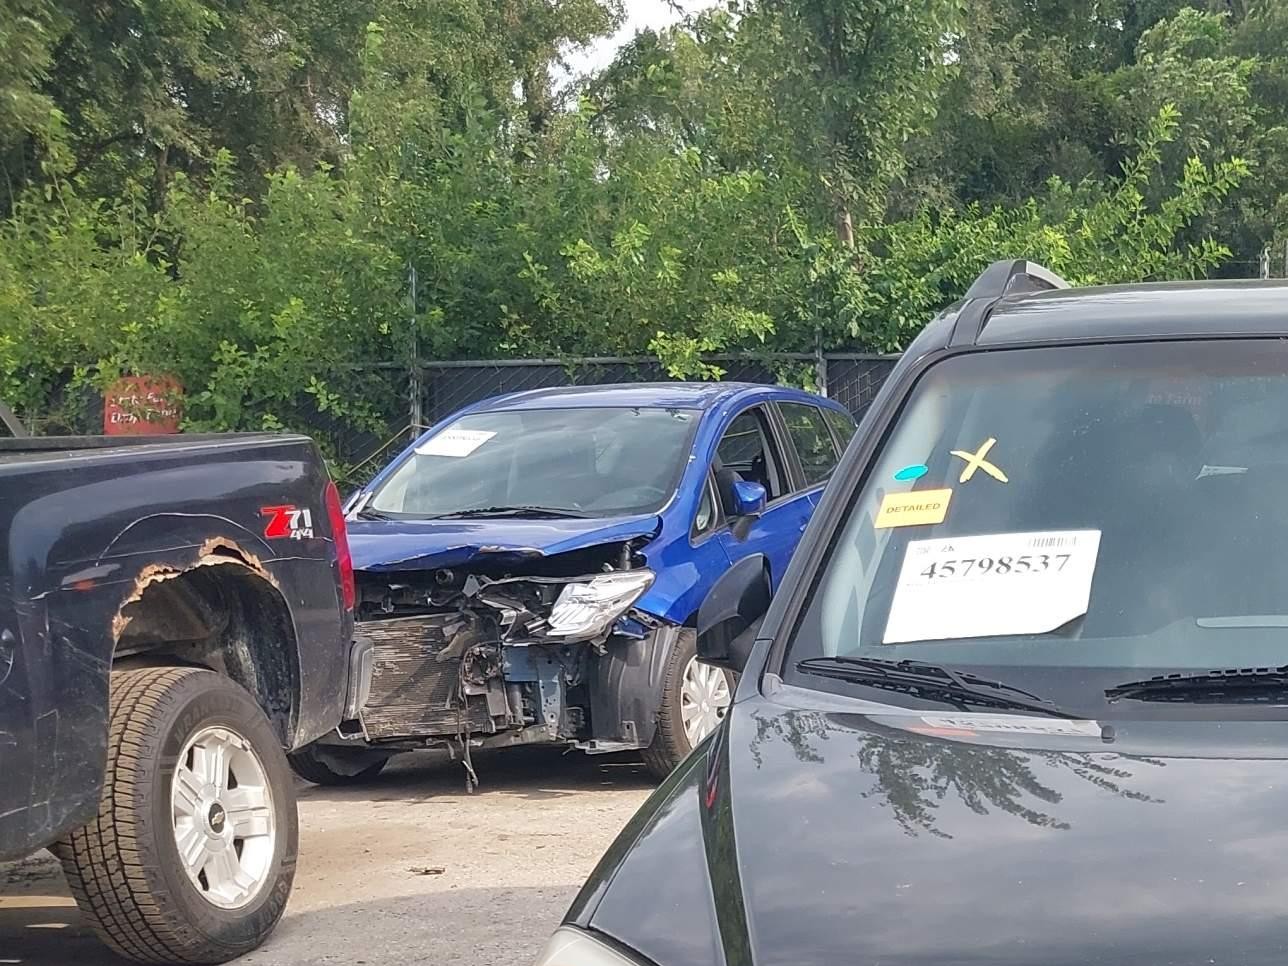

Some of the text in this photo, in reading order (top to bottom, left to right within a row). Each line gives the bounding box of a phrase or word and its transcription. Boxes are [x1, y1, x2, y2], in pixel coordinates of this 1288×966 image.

[886, 502, 941, 514] DETAILED
[260, 504, 313, 540] Z71
[920, 553, 1072, 580] 45798537
